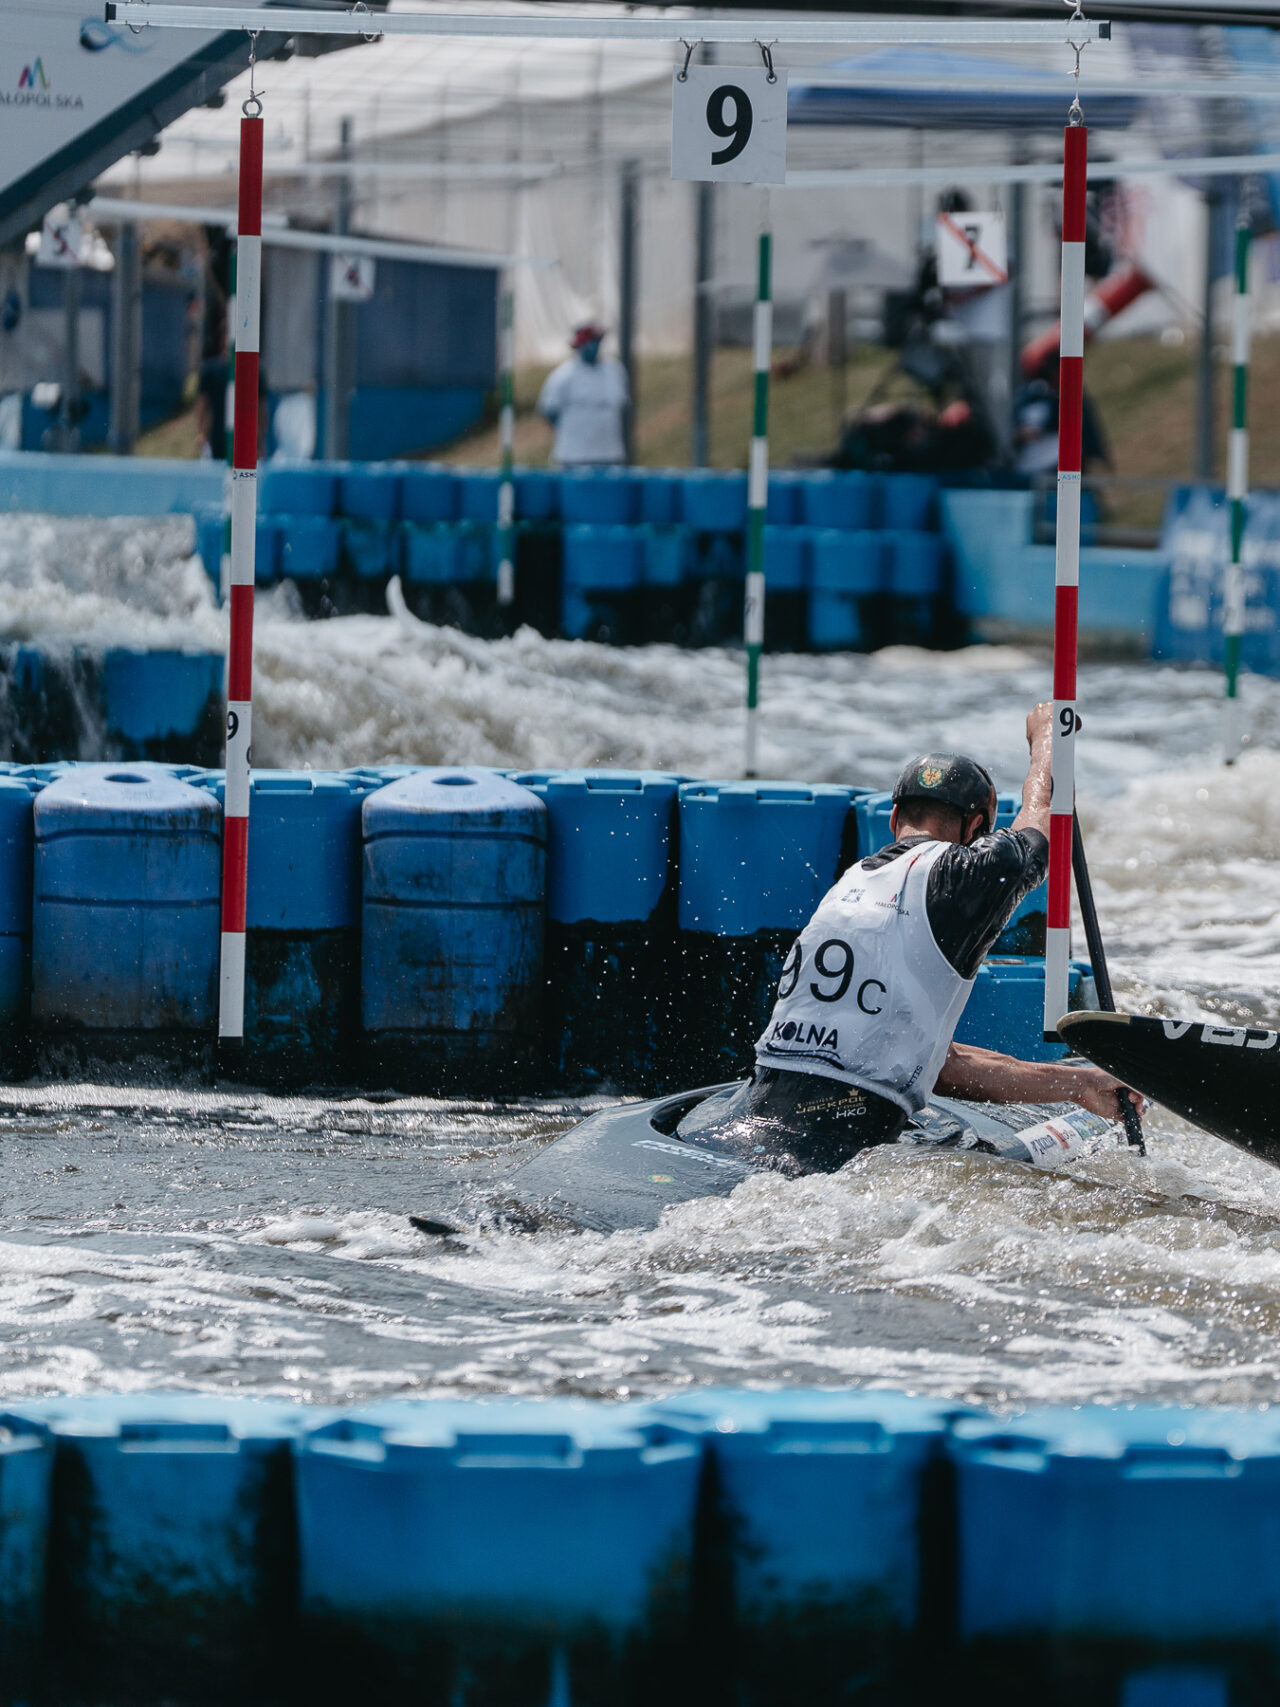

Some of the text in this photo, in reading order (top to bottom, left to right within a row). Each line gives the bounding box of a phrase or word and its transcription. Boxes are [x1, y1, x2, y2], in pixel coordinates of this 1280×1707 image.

[706, 85, 753, 165] 9
[964, 224, 981, 272] 7
[228, 710, 240, 741] 9
[1059, 707, 1075, 737] 9
[771, 1020, 839, 1050] KOLNA
[836, 1106, 868, 1119] HKO
